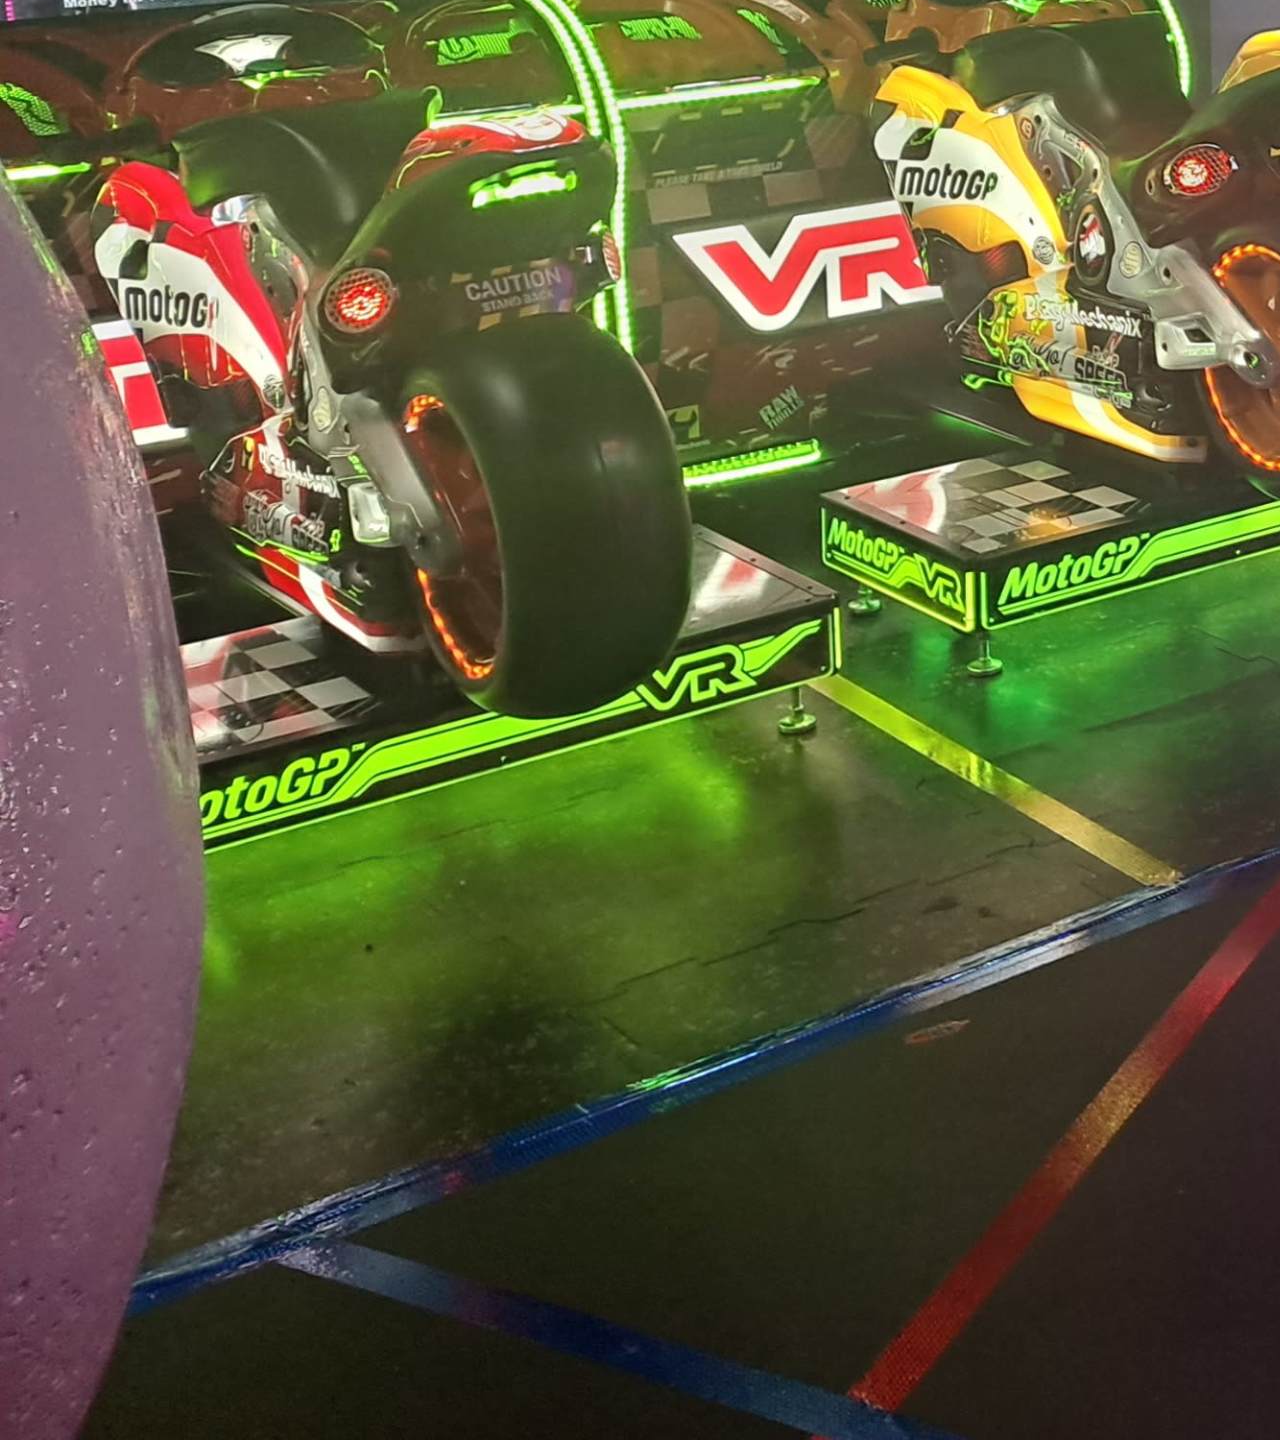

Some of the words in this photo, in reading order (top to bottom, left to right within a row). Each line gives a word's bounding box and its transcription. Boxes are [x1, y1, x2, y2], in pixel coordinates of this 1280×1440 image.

[465, 266, 562, 302] CAUTION
[480, 295, 523, 313] STAND
[688, 206, 936, 323] VR
[827, 519, 898, 567] MotoGP
[914, 552, 966, 613] VR
[1001, 534, 1139, 604] MotoGP
[199, 745, 350, 828] otoGP
[637, 643, 756, 713] VR
